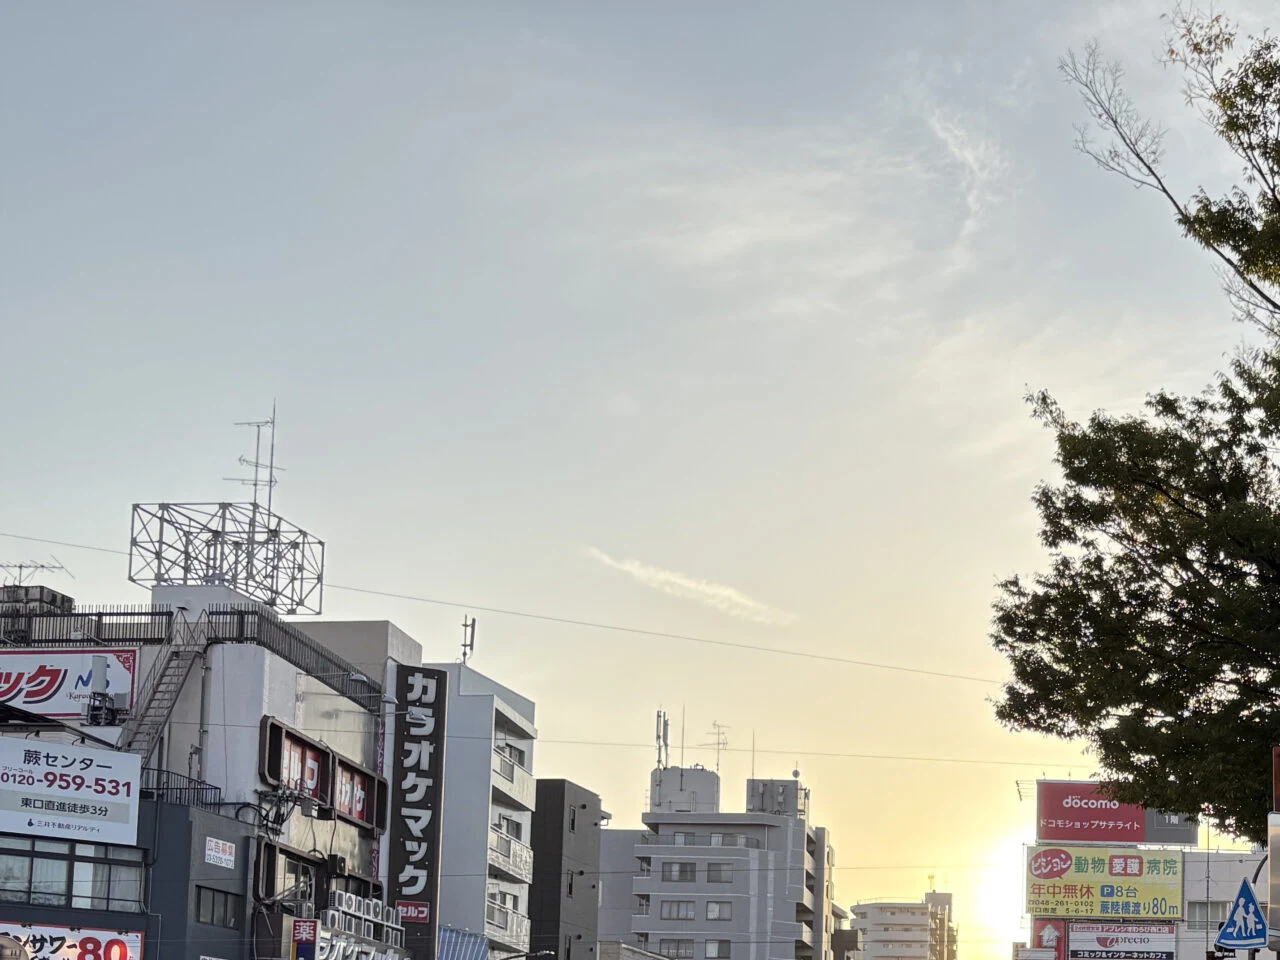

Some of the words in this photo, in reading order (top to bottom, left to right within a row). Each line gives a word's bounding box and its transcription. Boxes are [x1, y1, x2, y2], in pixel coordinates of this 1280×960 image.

[24, 749, 112, 771] 蕨センター
[1, 771, 131, 798] 0120-959-531
[399, 672, 438, 896] カラオケマック
[21, 797, 108, 817] 東口直進徒歩3分
[1062, 795, 1119, 809] docomo
[1039, 818, 1140, 831] ドコモショップサテライト
[1030, 883, 1094, 899] 年中無休
[397, 904, 429, 919] セルフ
[294, 921, 315, 941] 薬
